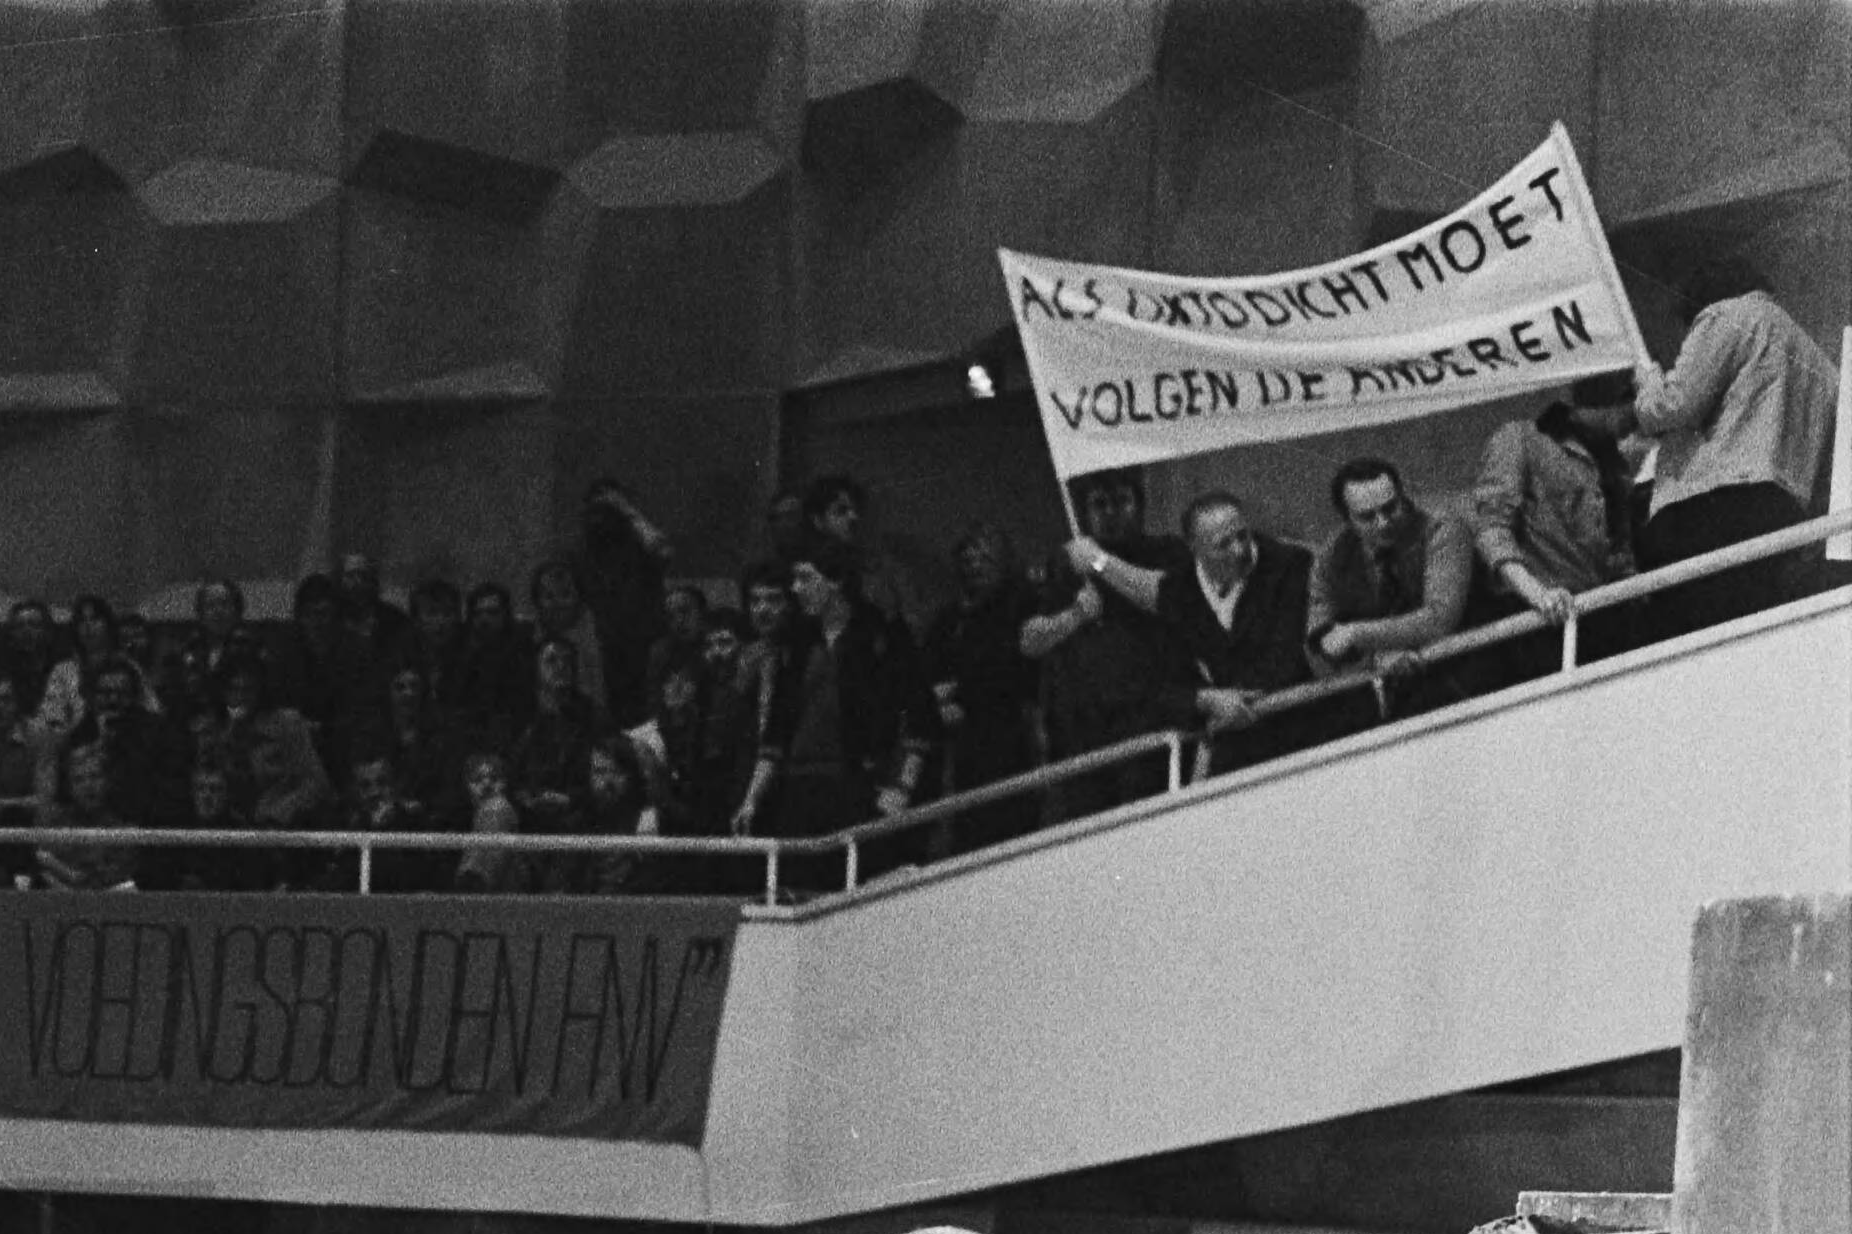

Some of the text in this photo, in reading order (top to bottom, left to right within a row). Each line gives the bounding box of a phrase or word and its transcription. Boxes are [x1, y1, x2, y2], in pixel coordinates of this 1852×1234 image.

[1021, 275, 1101, 322] ALS
[1399, 167, 1567, 292] MOET
[1051, 304, 1593, 431] VOLGEN DE ANDEREN
